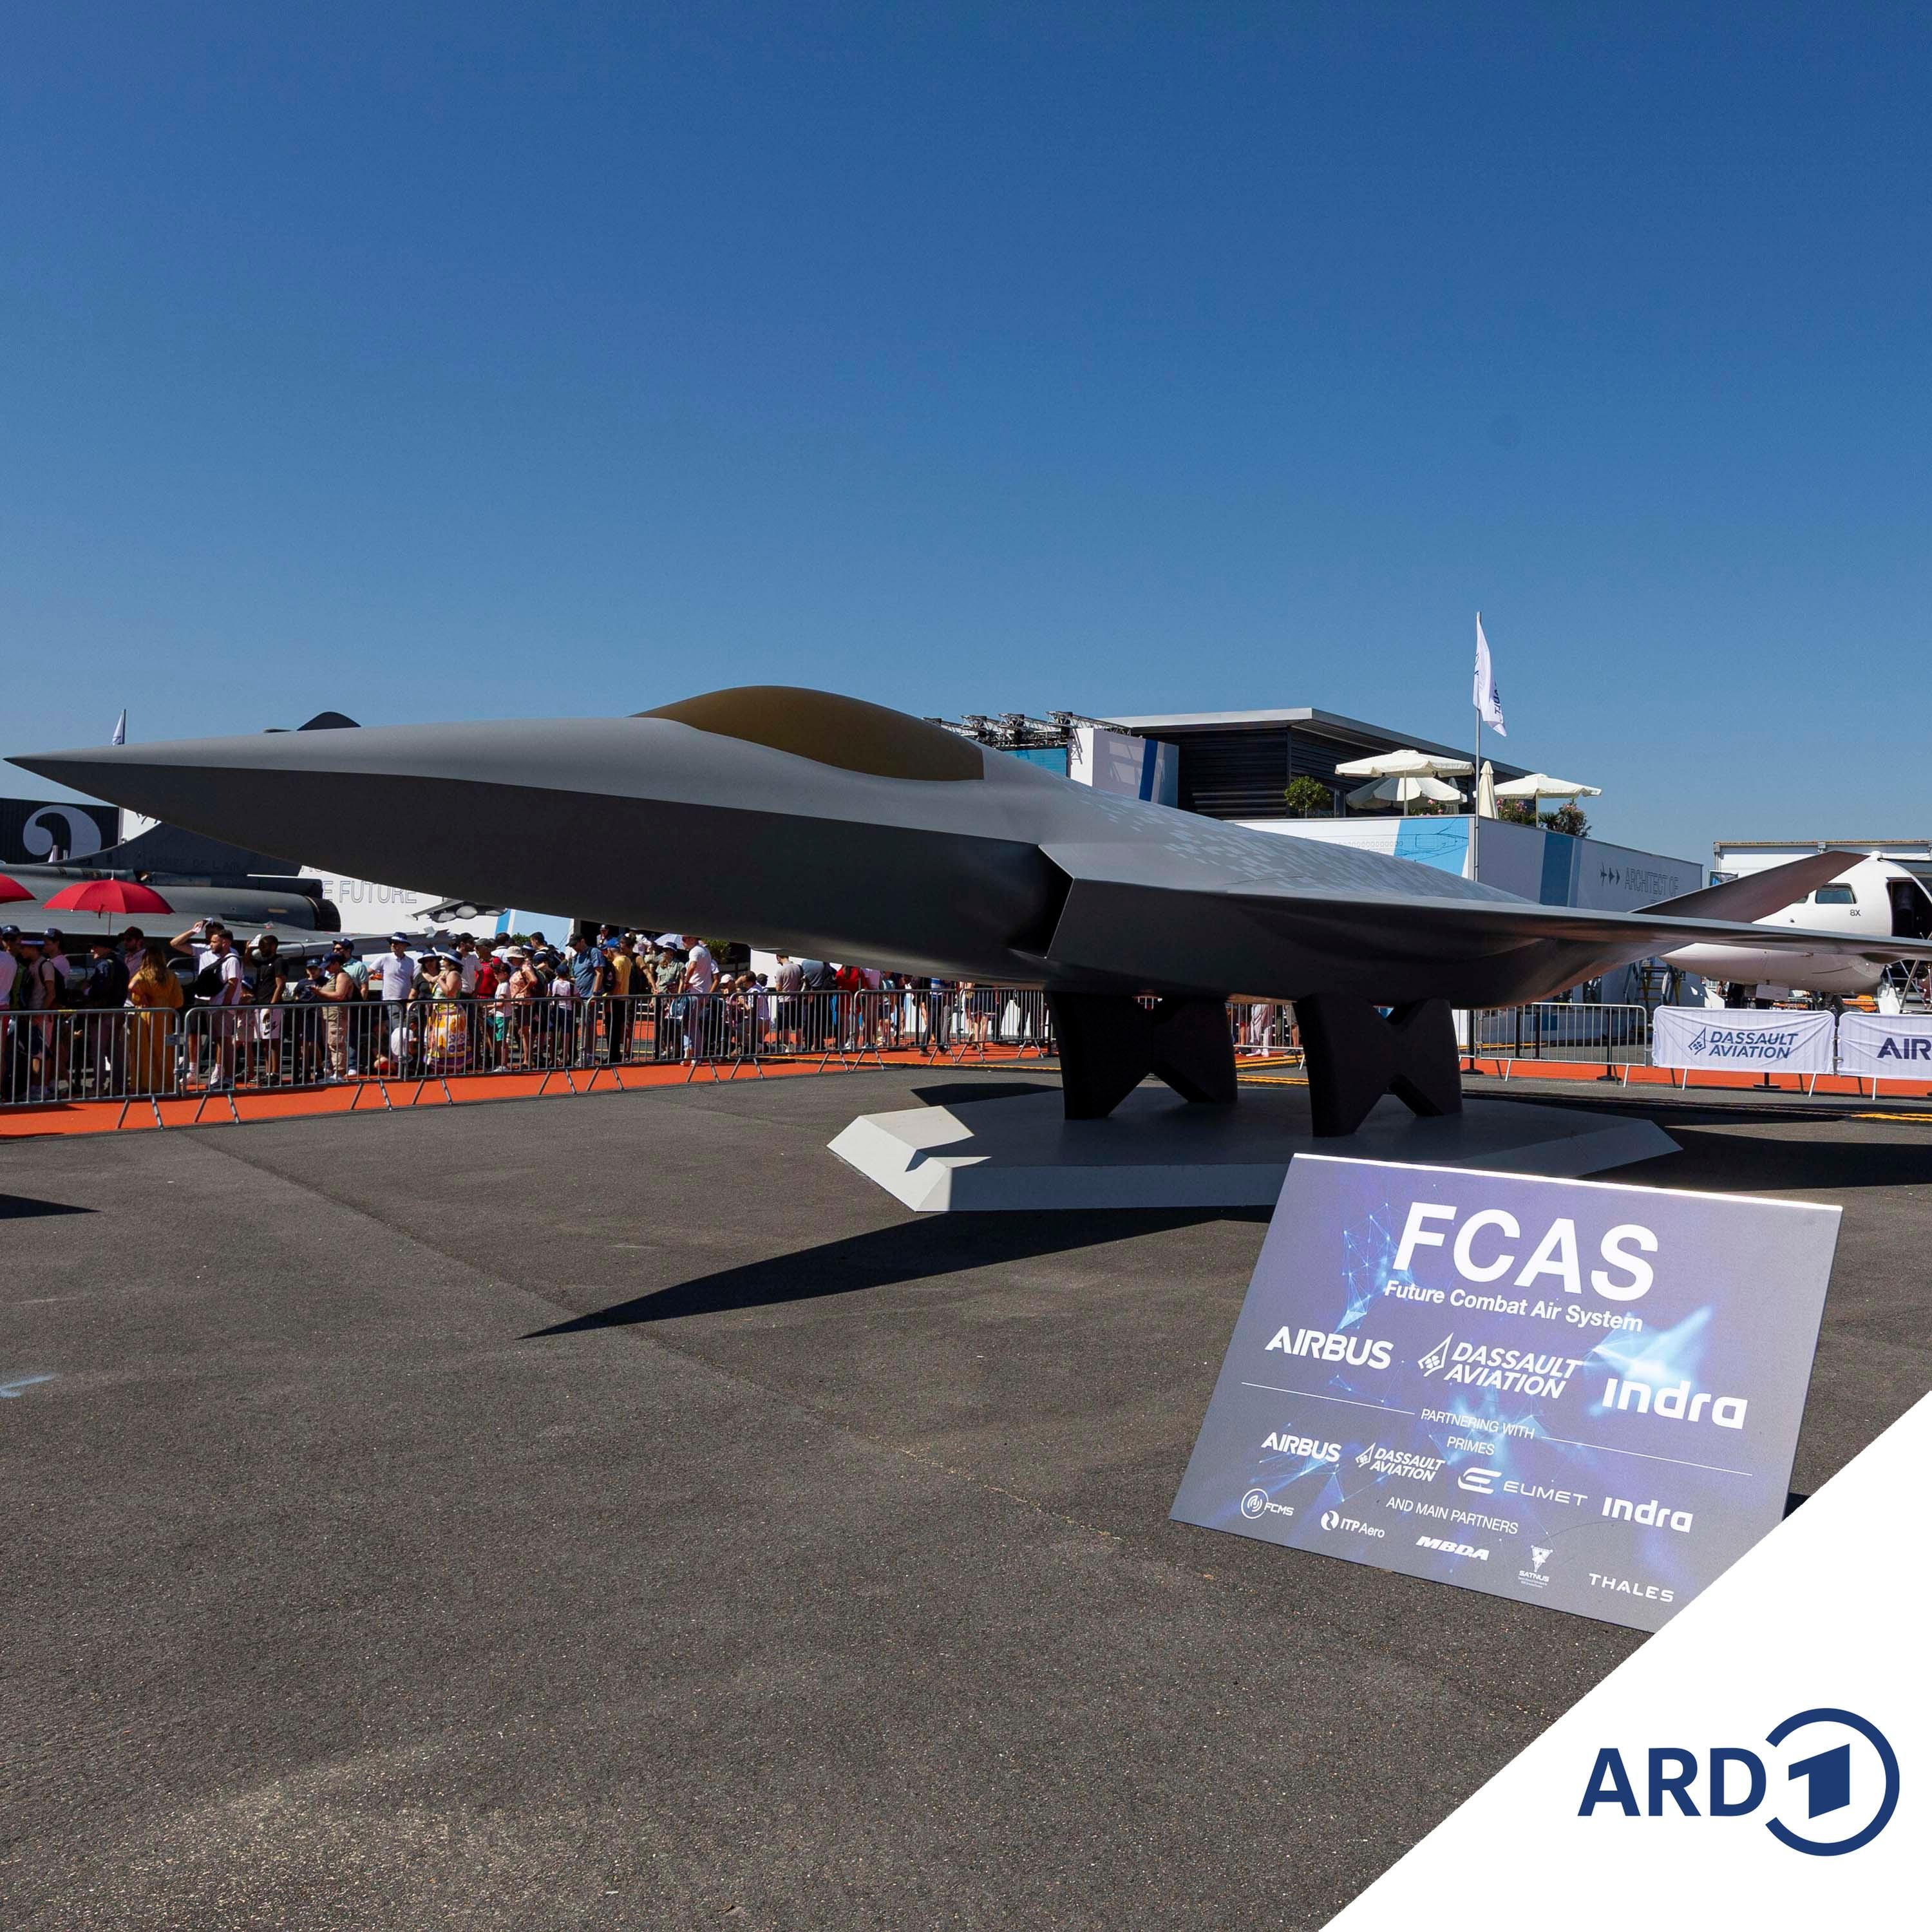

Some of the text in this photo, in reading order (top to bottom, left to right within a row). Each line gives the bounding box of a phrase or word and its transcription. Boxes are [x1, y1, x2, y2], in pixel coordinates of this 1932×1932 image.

[339, 880, 417, 904] FUTURE
[1709, 1031, 1799, 1046] DASSAULT
[1877, 1037, 1932, 1061] AIR
[1709, 1044, 1792, 1059] AVIATION
[1392, 1202, 1658, 1302] FCAS
[1385, 1280, 1643, 1332] Future Combat Air System
[1265, 1326, 1394, 1369] AIRBUS
[1452, 1342, 1584, 1379] DASSAULT
[1444, 1364, 1567, 1399] AVIATION
[1421, 1408, 1536, 1439] PARTNERING WITH
[1261, 1432, 1341, 1462] AIRBUS
[1446, 1436, 1495, 1455] PRIMES
[1370, 1461, 1436, 1482] AVIATION
[1374, 1448, 1446, 1471] DASSAULT
[1503, 1481, 1588, 1506] EUMET
[1264, 1502, 1294, 1516] FCMS
[1386, 1497, 1519, 1535] AND MAIN PARTNERS
[1416, 1536, 1490, 1561] MBDA
[1589, 1573, 1675, 1602] THALES
